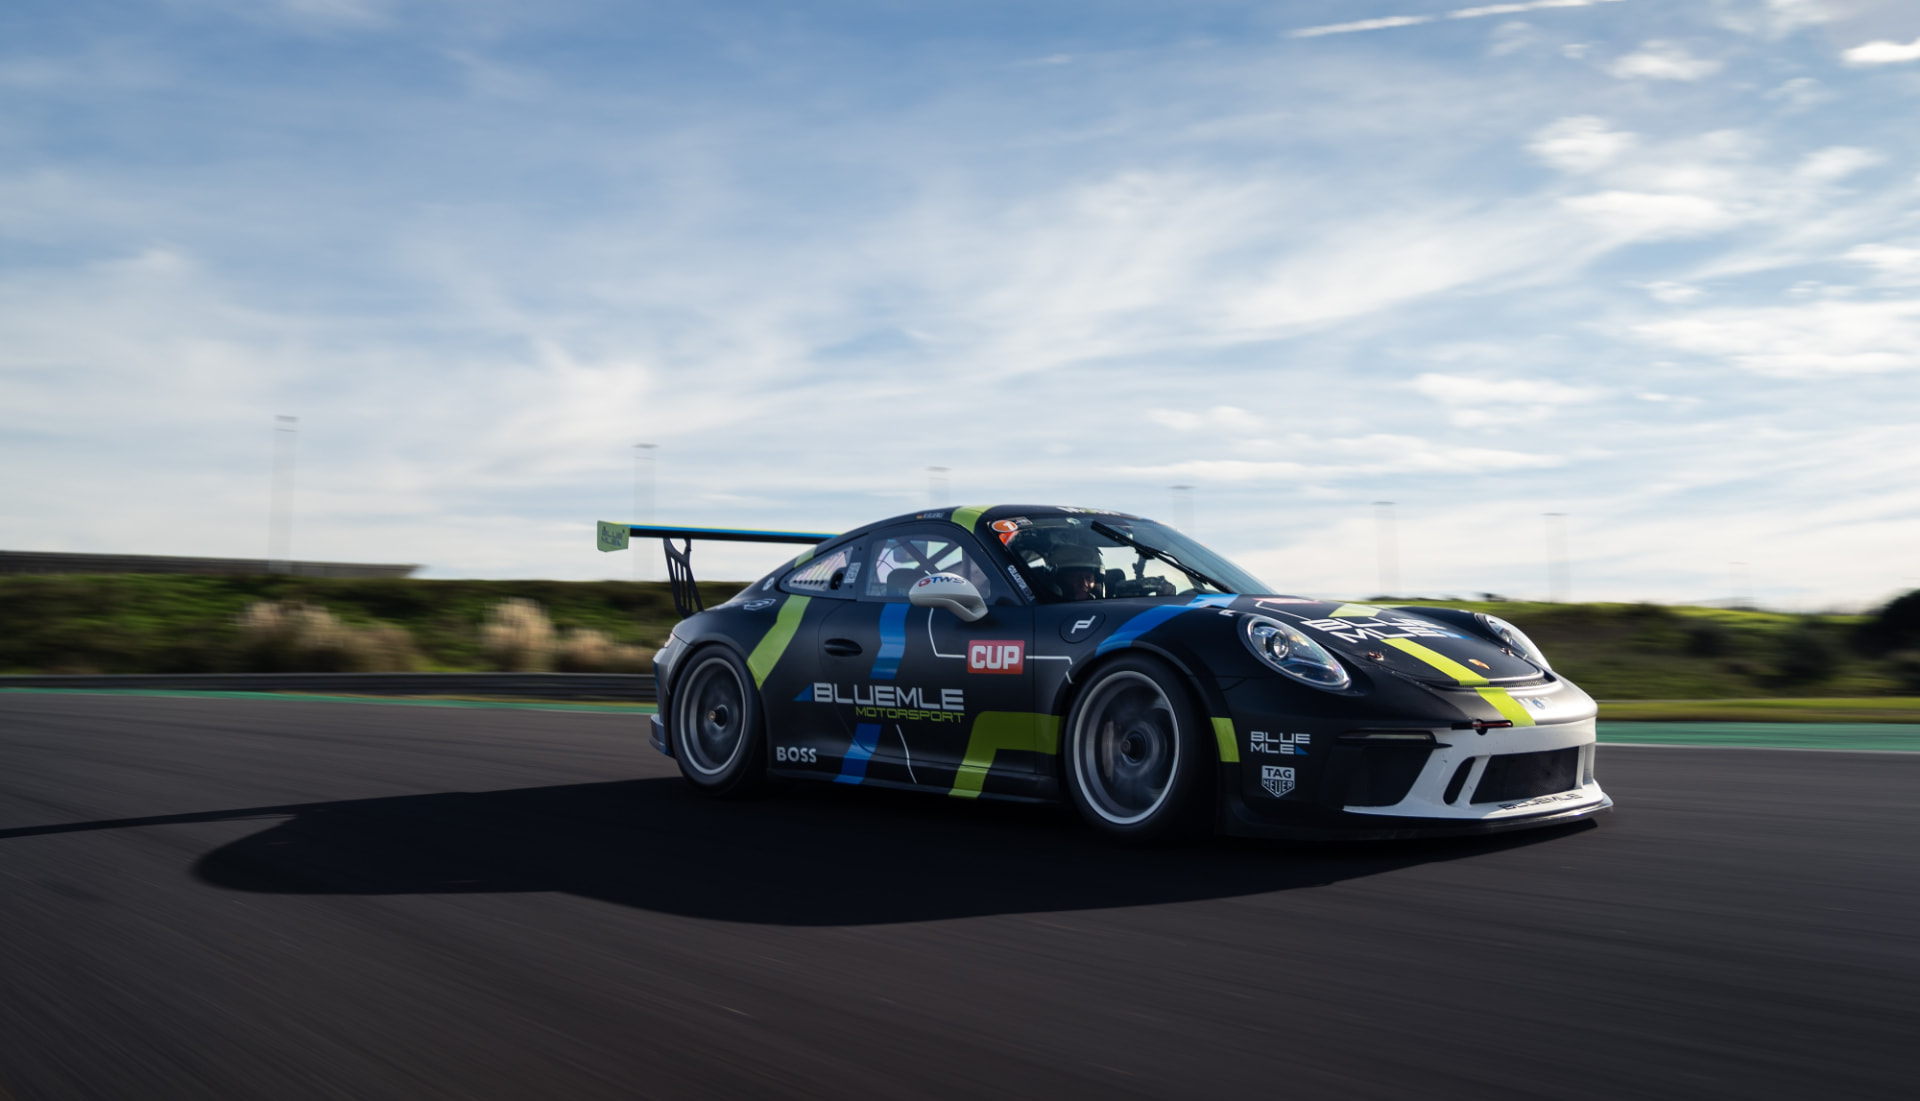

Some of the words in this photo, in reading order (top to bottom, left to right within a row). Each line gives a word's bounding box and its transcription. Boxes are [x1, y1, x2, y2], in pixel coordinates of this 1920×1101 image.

[1300, 617, 1448, 631] BLUE
[1329, 627, 1448, 644] MLE
[971, 645, 1020, 670] CUP
[813, 682, 965, 711] BLUEMLE
[855, 706, 965, 724] MOTORSPORT
[1250, 731, 1311, 744] BLUE
[776, 746, 817, 763] BOSS
[1250, 742, 1295, 755] MLE
[1264, 767, 1292, 779] TAG
[1263, 779, 1293, 795] HEUER
